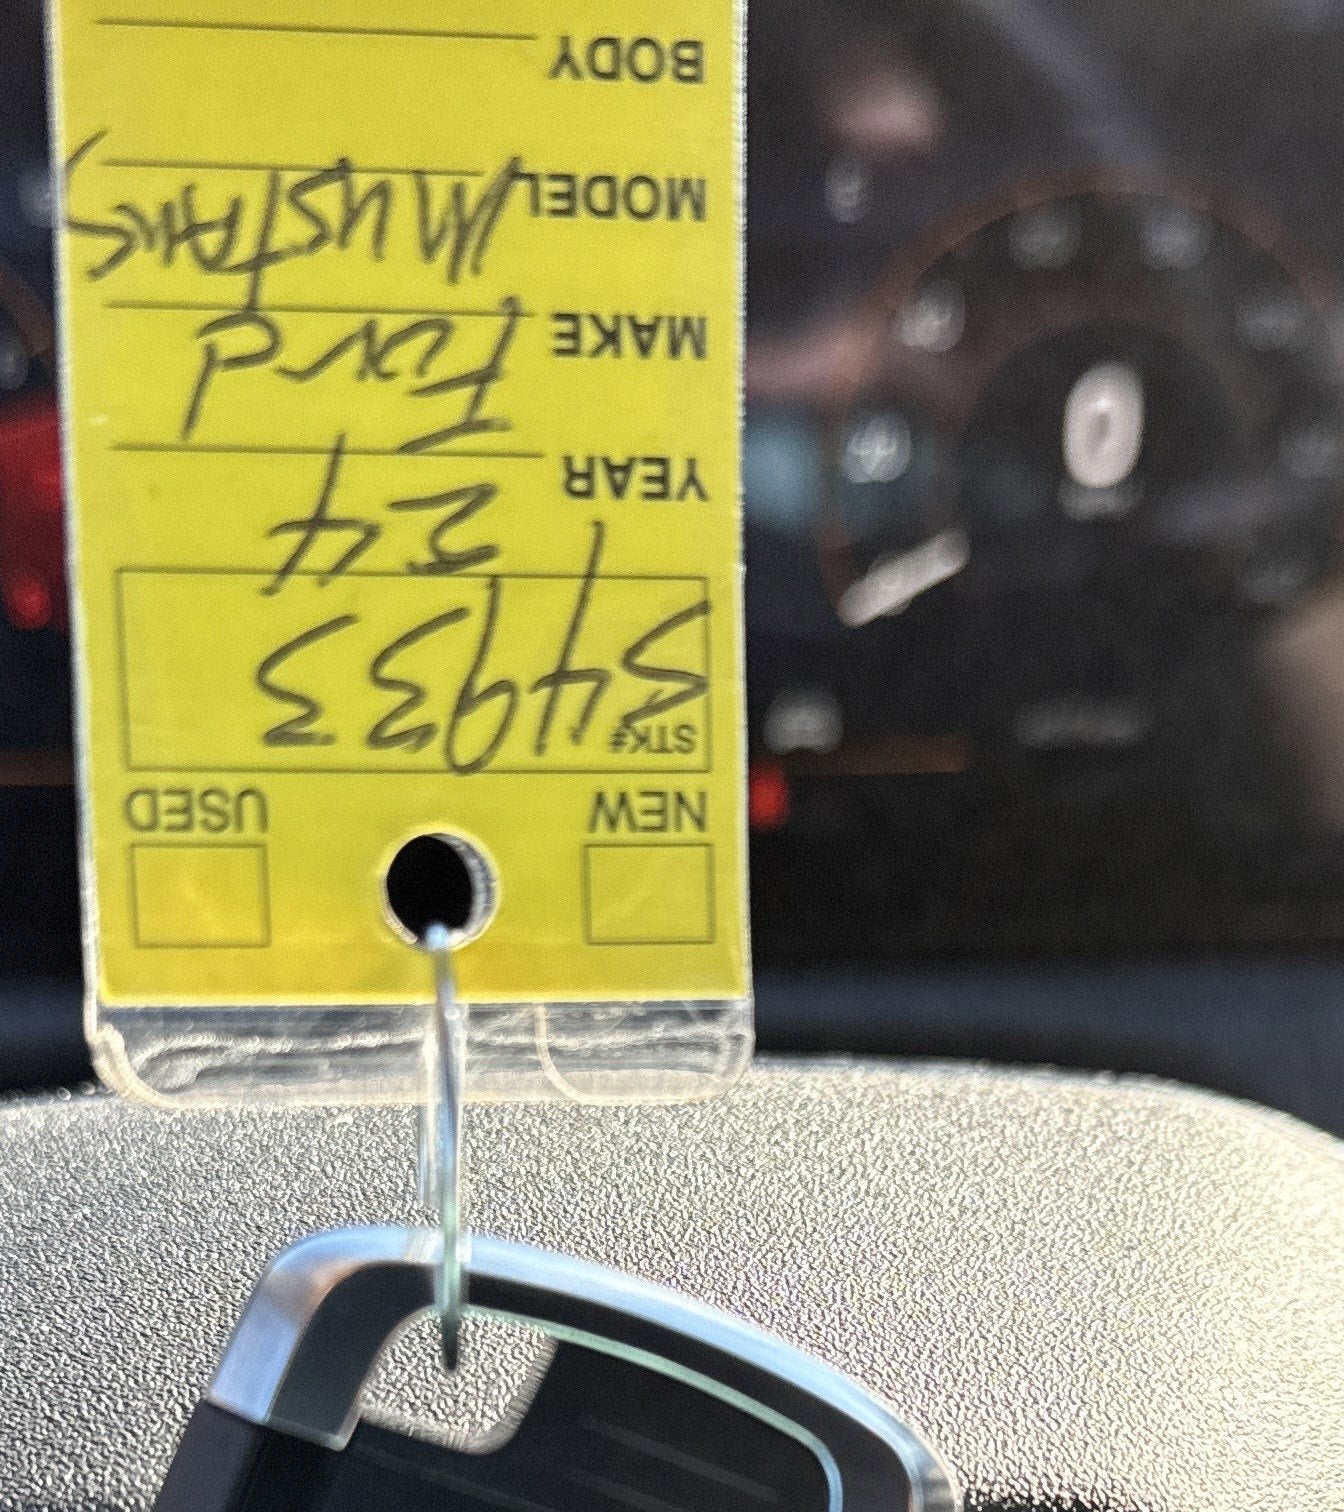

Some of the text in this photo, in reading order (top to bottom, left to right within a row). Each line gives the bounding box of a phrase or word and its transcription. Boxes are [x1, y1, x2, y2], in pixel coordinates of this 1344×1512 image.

[548, 35, 705, 84] BODY
[514, 176, 706, 223] MODEL
[551, 312, 707, 360] MAKE
[562, 455, 709, 501] YEAR
[608, 723, 697, 755] STK#
[124, 787, 271, 833] USED
[587, 789, 709, 831] NEW
